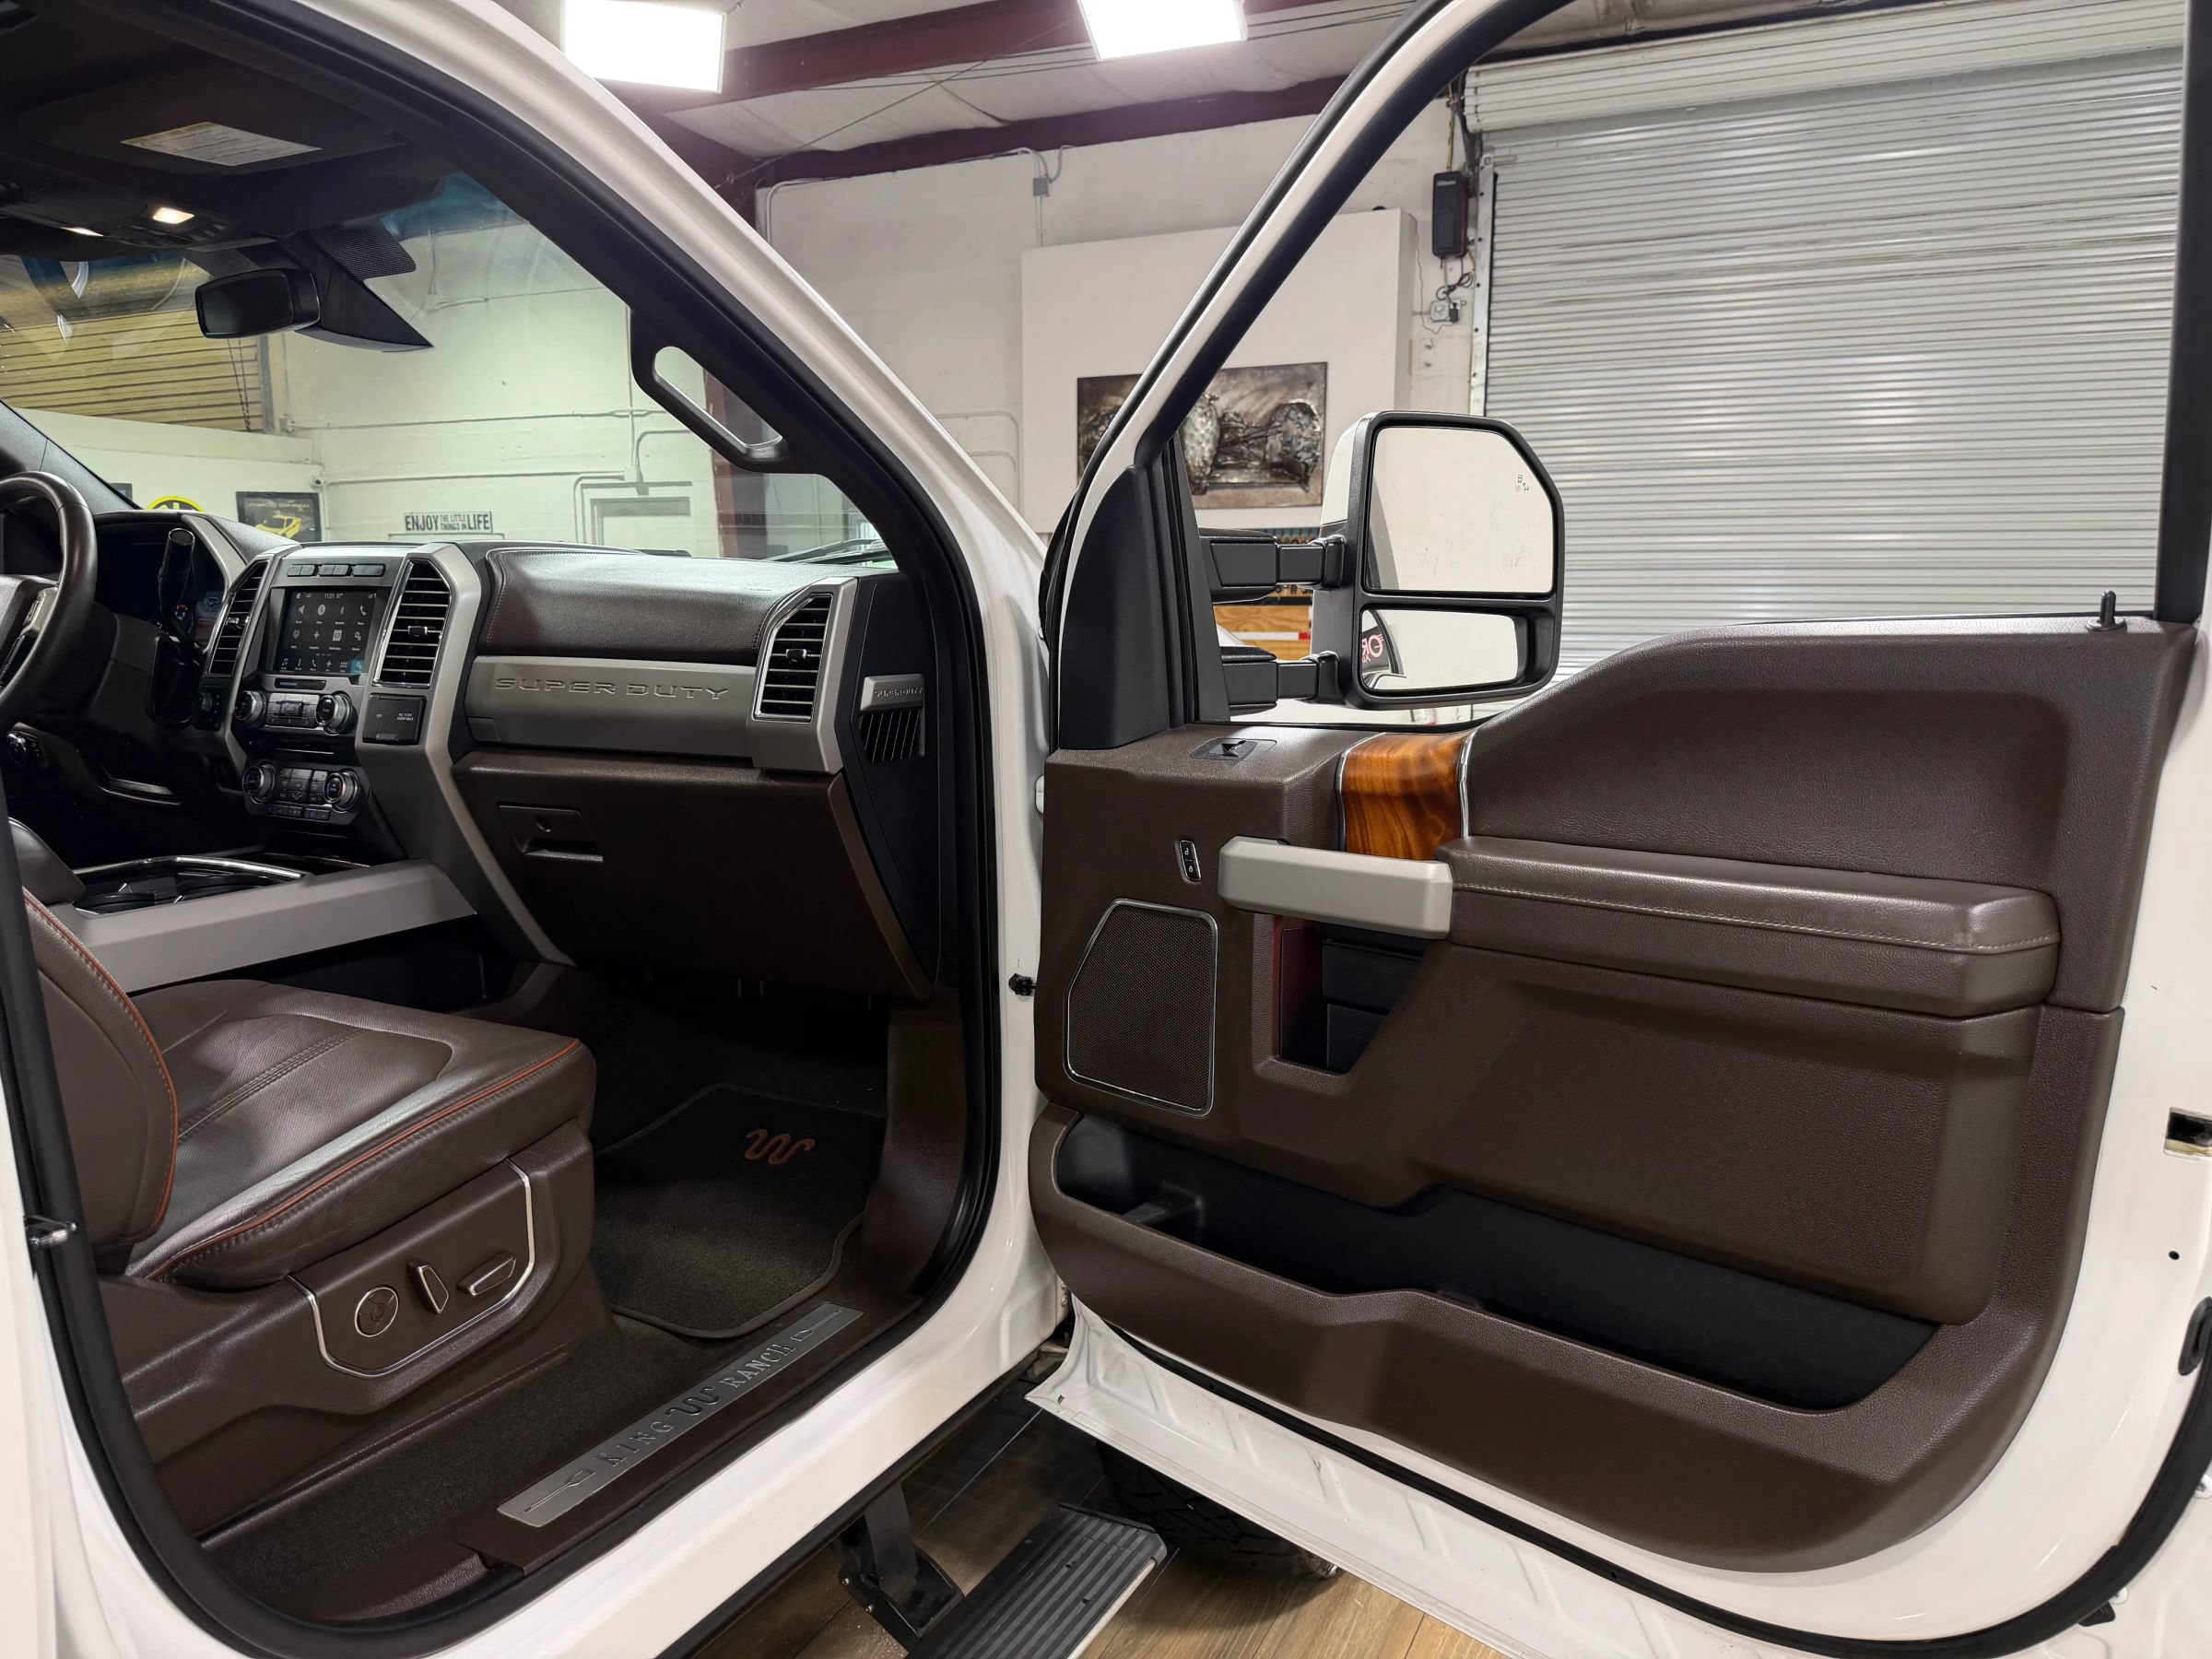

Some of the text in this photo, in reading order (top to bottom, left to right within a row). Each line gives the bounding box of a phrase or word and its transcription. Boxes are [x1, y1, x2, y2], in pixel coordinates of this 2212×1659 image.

[405, 515, 439, 531] ENJOY
[440, 514, 449, 523] THE
[467, 513, 490, 530] LIFE
[440, 523, 460, 531] THINGS
[495, 677, 729, 700] SUPER DUTY
[594, 1343, 796, 1467] KING RANCH
